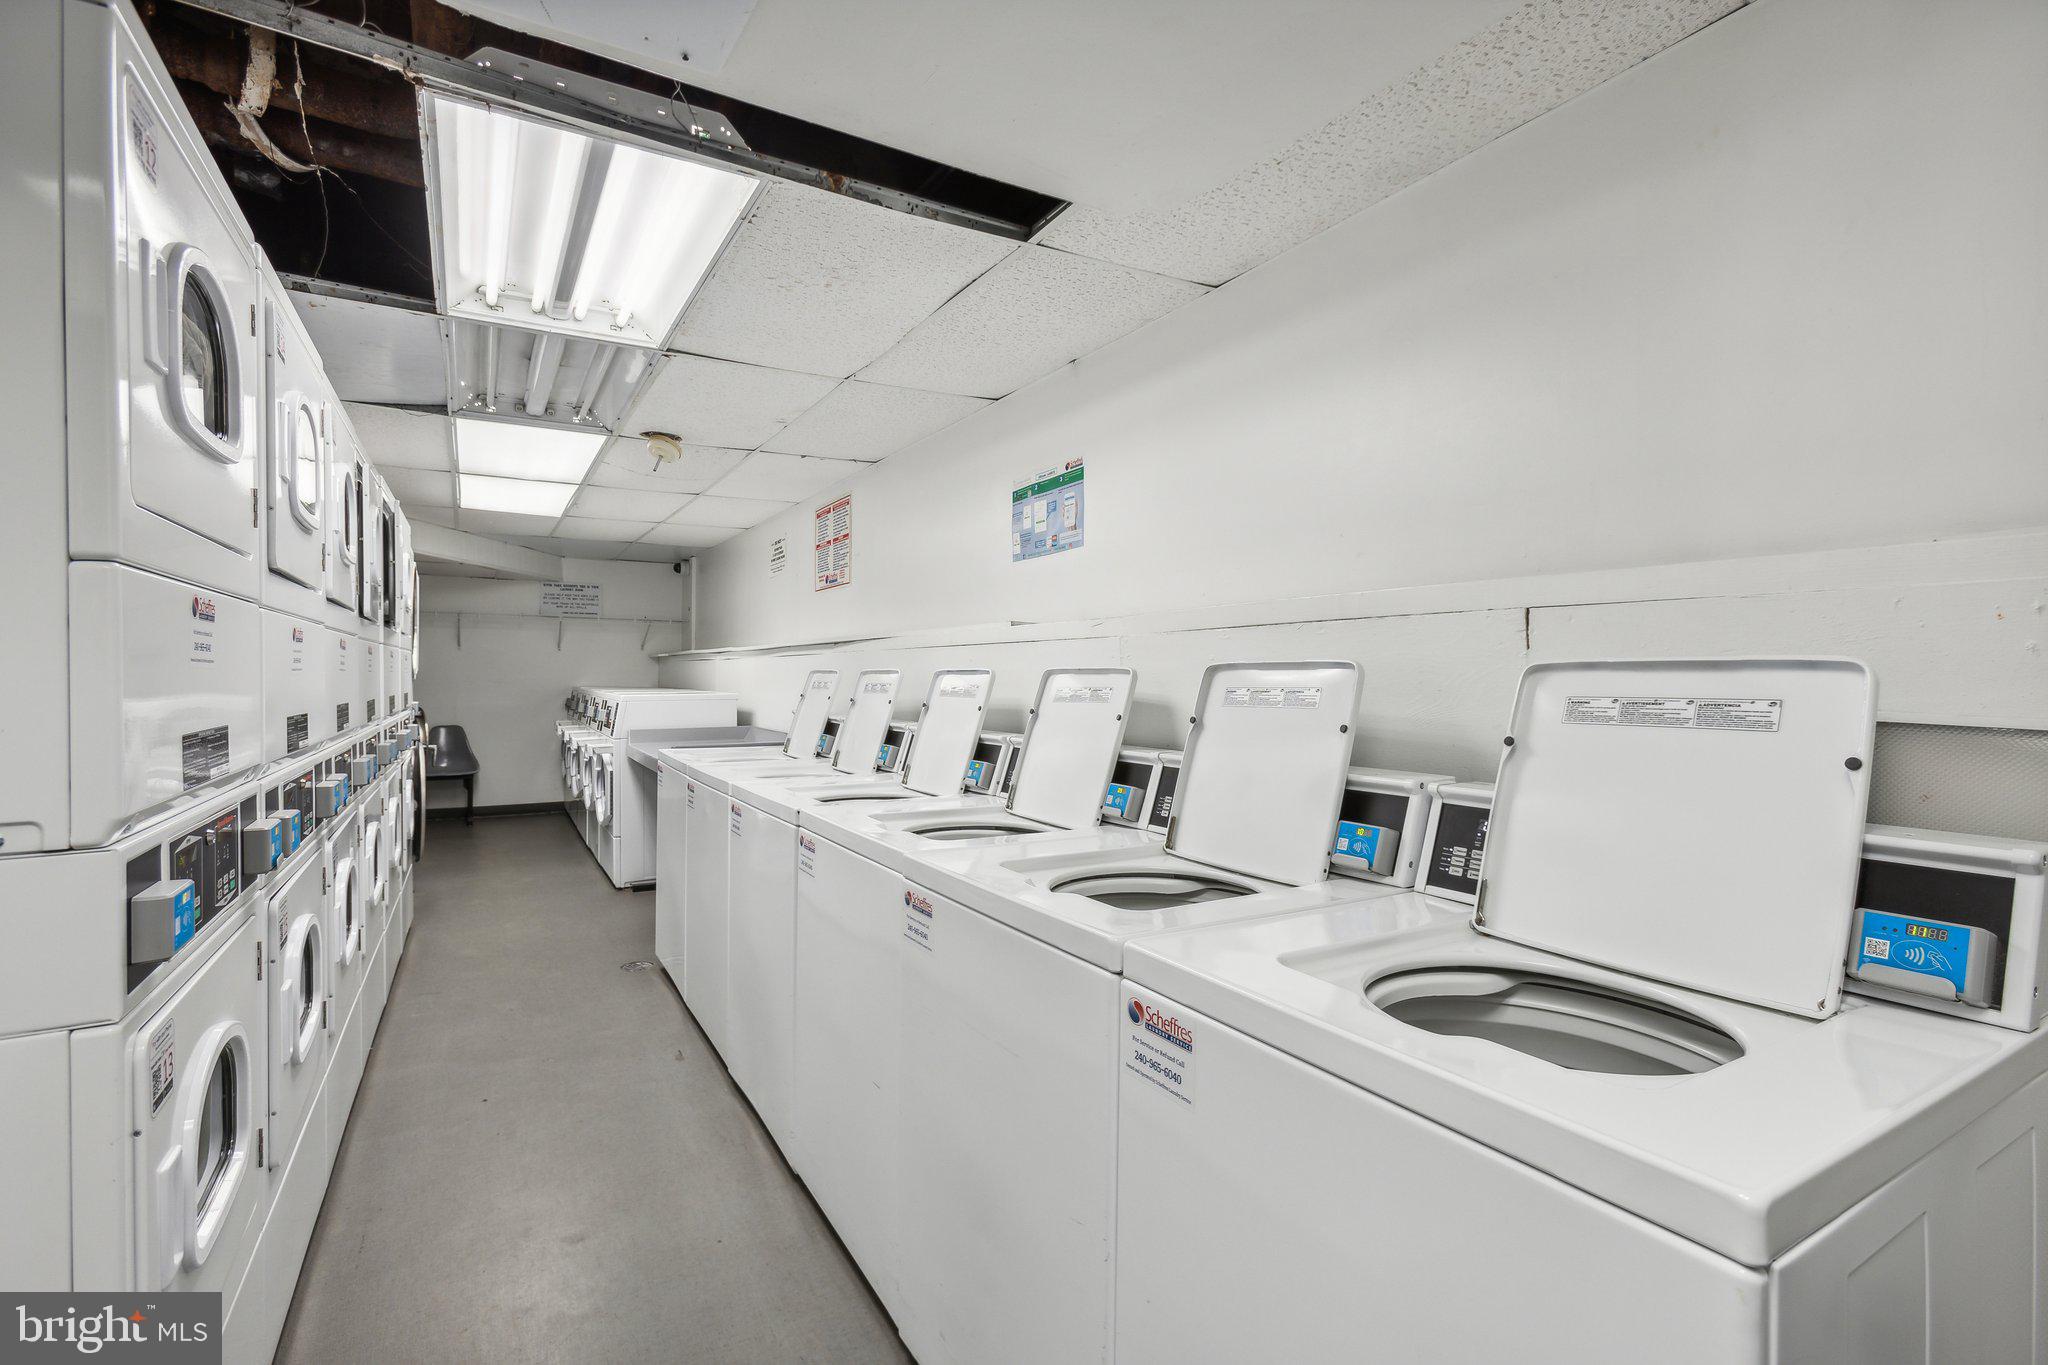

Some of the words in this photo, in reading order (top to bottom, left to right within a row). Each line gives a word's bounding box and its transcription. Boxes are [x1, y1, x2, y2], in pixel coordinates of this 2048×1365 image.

[1145, 1006, 1193, 1043] Scheffres
[163, 1051, 174, 1084] 13
[1134, 1050, 1182, 1085] 240-965-6040
